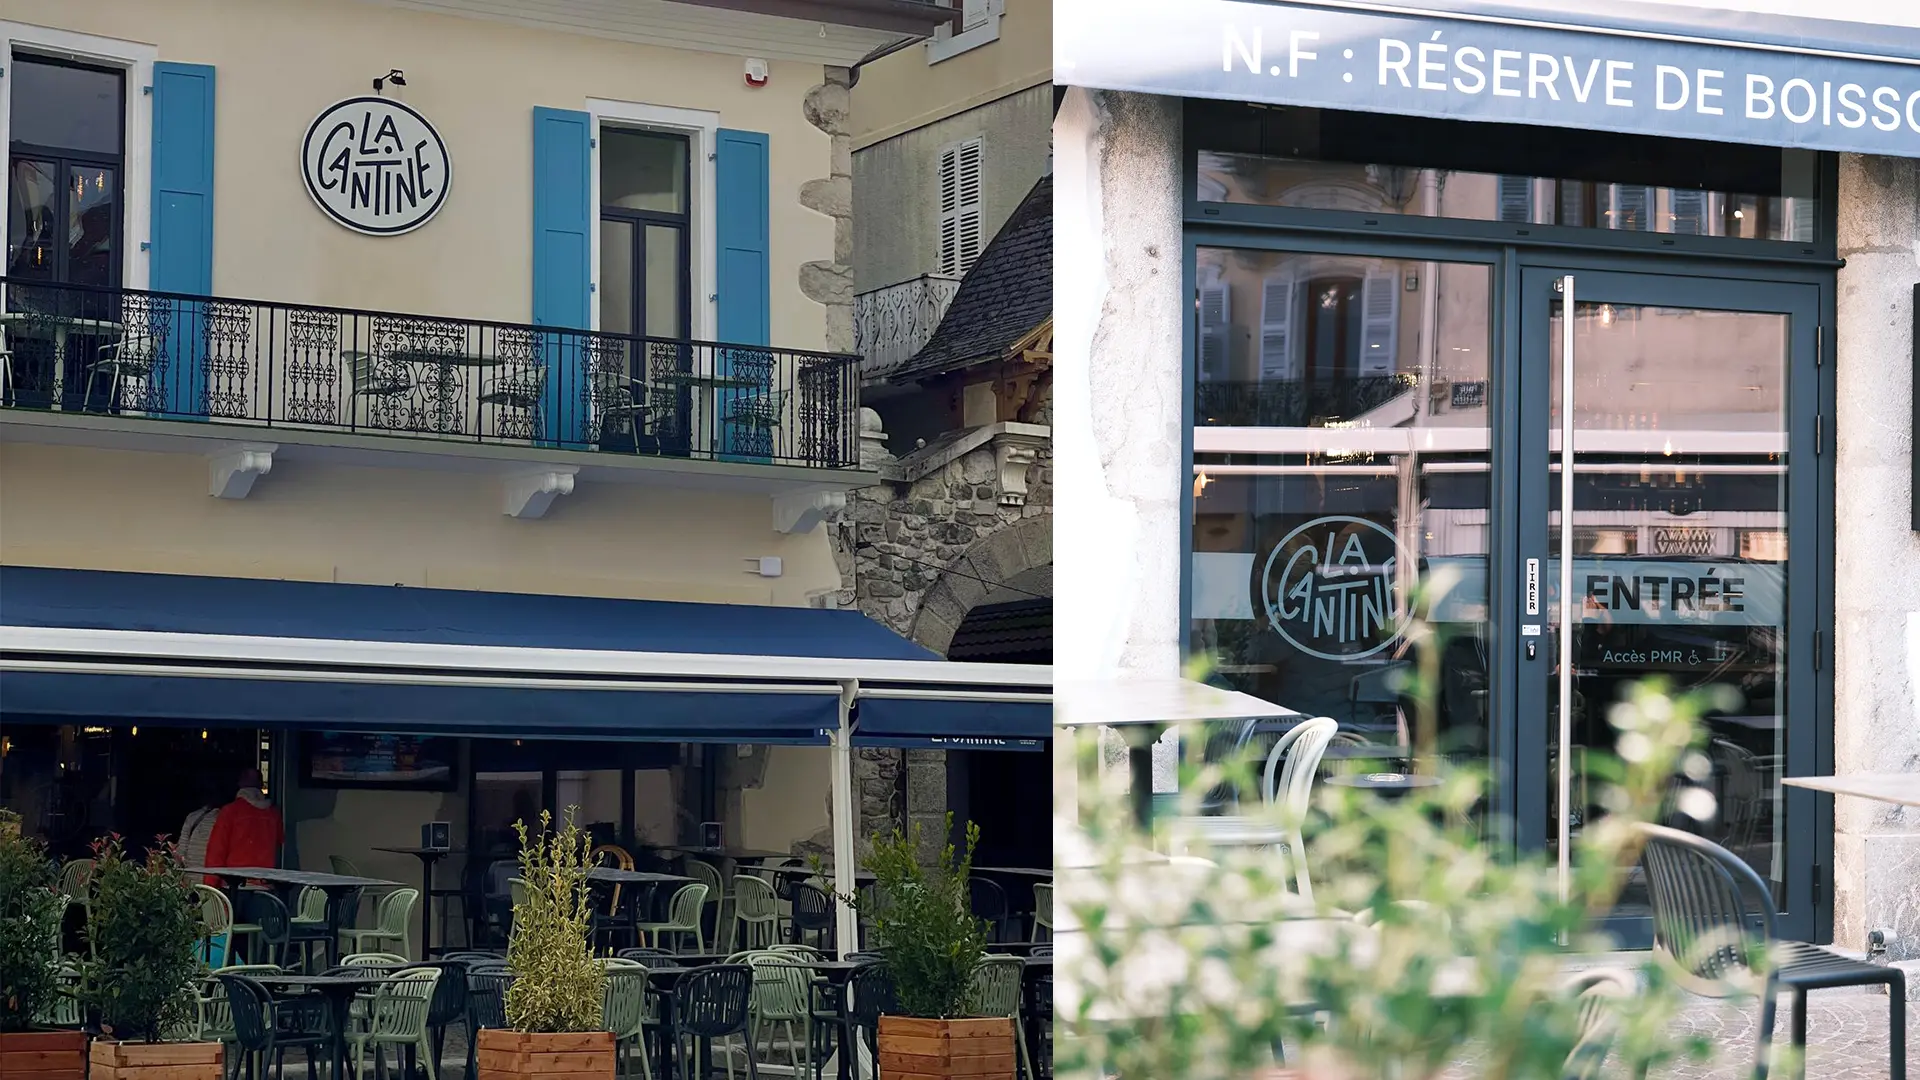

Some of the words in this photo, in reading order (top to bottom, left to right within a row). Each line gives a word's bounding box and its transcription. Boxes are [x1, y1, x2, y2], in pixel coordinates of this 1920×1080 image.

[1223, 23, 1320, 78] N.F
[1378, 30, 1634, 107] RÉSERVE
[1656, 64, 1724, 115] DE
[360, 112, 404, 155] LA
[318, 122, 433, 216] CANTINE
[1322, 532, 1371, 578] LA
[1278, 545, 1402, 643] CANTINE
[1586, 567, 1745, 612] ENTRÉE
[1603, 650, 1646, 663] Accès
[1651, 650, 1682, 663] PMR
